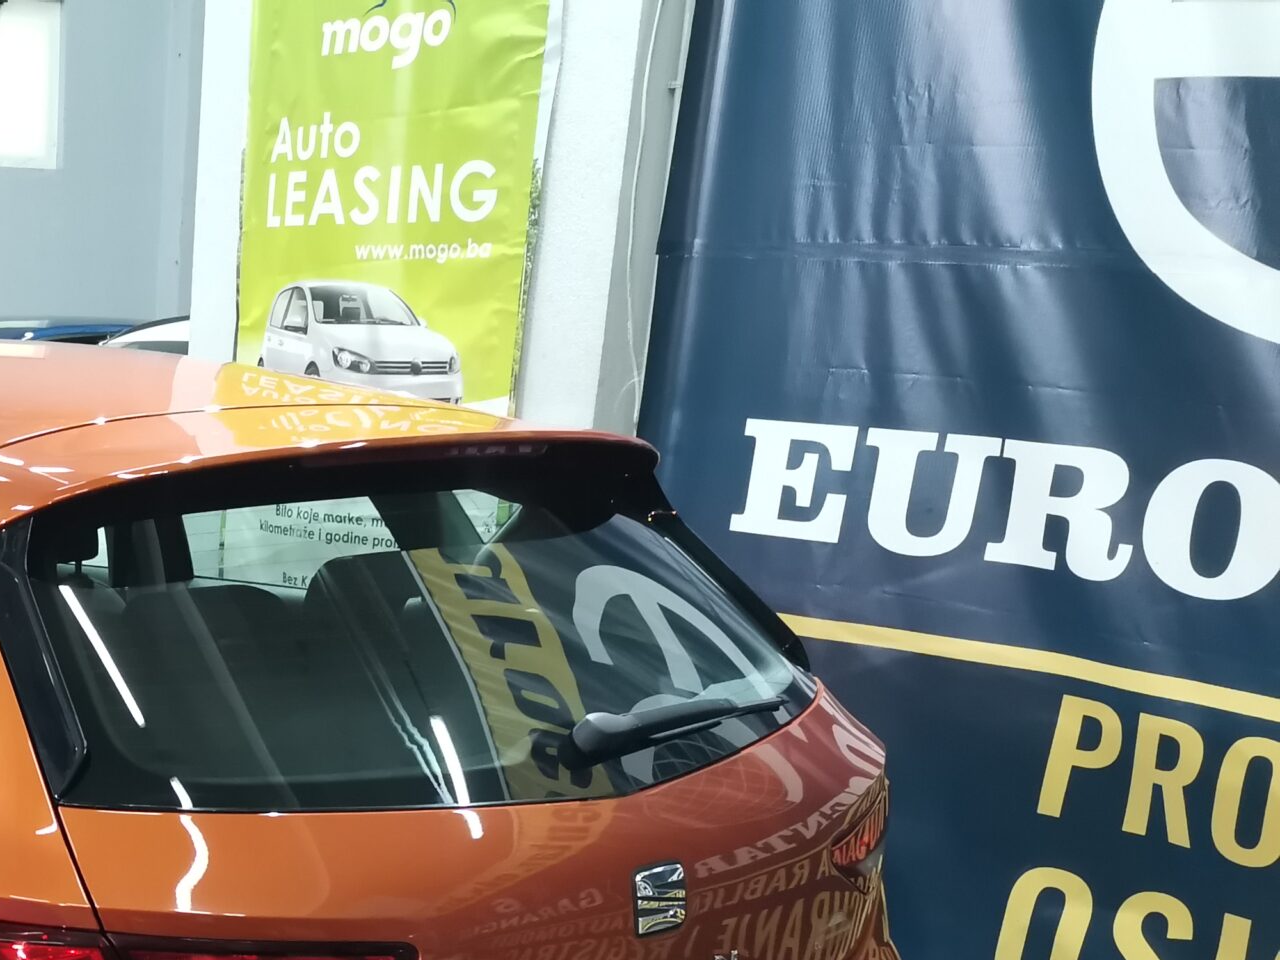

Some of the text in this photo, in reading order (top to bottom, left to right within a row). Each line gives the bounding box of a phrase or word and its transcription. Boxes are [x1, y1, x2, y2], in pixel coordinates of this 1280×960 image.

[321, 7, 452, 70] mogo
[271, 111, 361, 163] Auto
[266, 160, 498, 228] LEASING
[355, 238, 493, 264] www.mogo.ba
[259, 519, 315, 541] kilometraže
[325, 531, 369, 546] godine
[275, 503, 294, 519] Bilo
[296, 508, 320, 525] koje
[323, 512, 367, 528] marke,
[728, 417, 1280, 602] EURO
[282, 571, 298, 586] Bez
[1036, 693, 1280, 869] PRO
